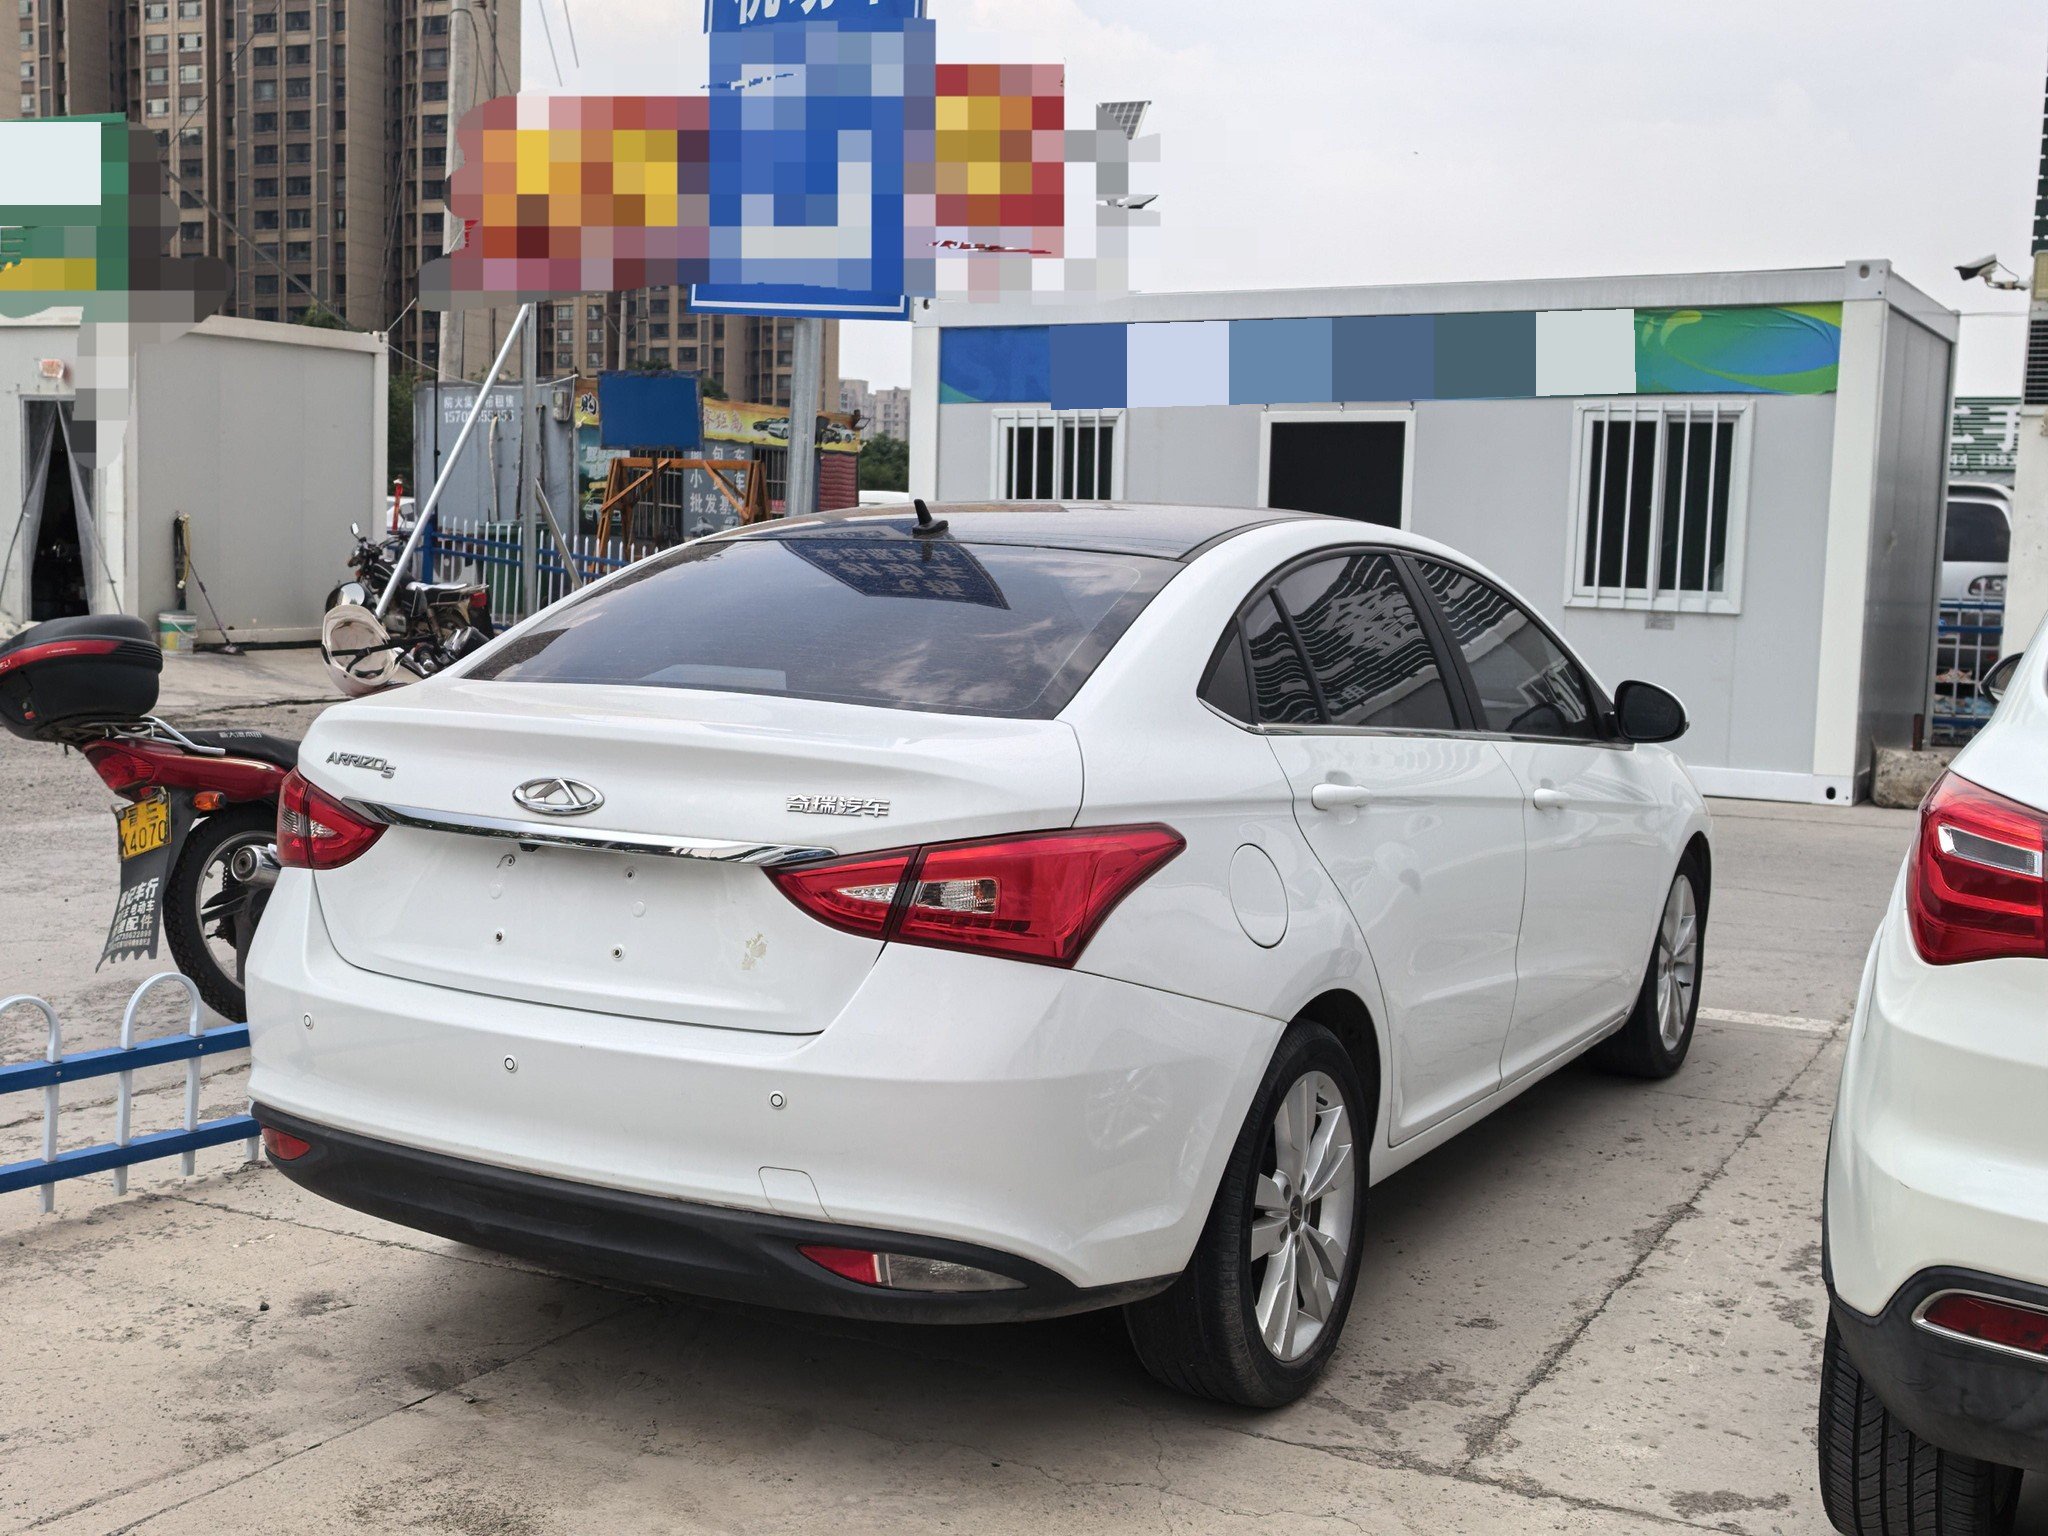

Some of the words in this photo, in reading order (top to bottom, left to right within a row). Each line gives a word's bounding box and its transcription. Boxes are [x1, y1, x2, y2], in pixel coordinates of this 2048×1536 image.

[690, 469, 745, 491] 小车
[786, 793, 891, 818] 奇瑞汽车
